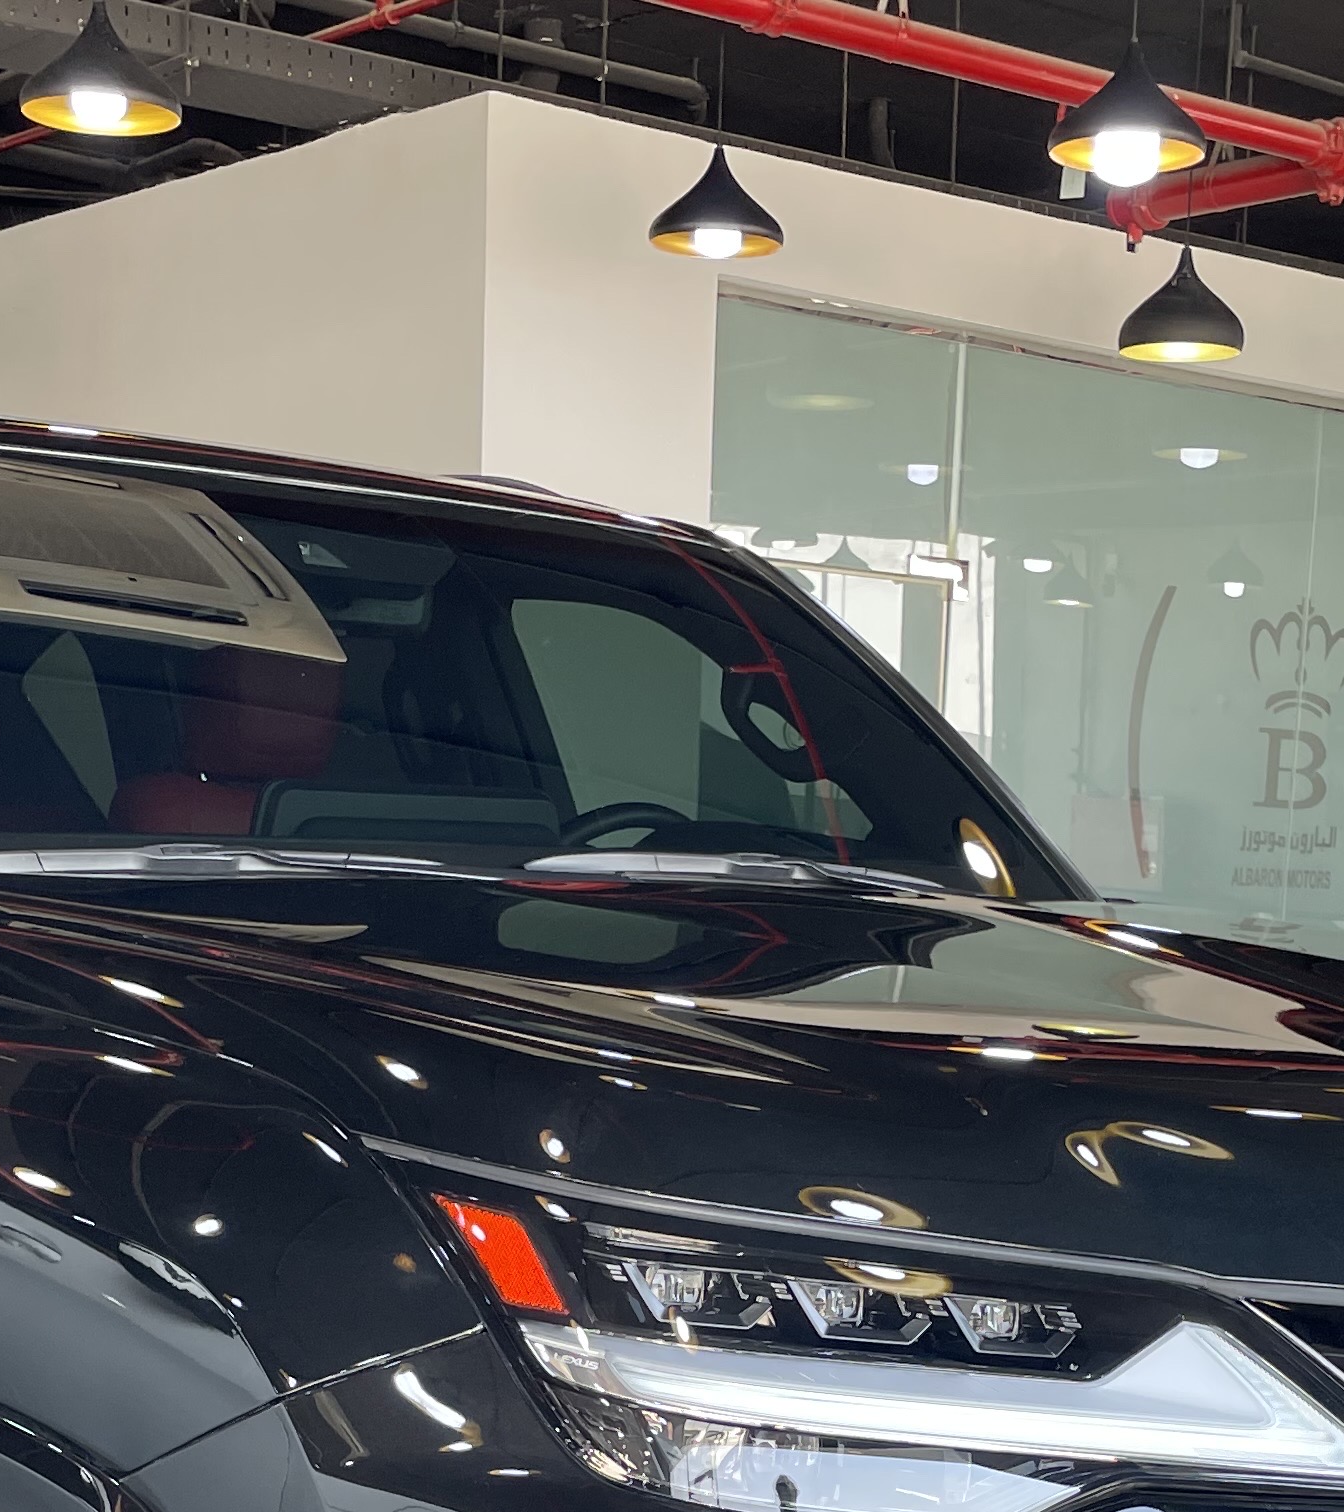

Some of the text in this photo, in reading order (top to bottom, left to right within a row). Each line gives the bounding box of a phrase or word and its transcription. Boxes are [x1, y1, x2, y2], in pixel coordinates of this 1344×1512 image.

[1253, 727, 1327, 810] B
[1290, 825, 1338, 854] البارون
[1231, 866, 1332, 889] ALBARON MOTORS
